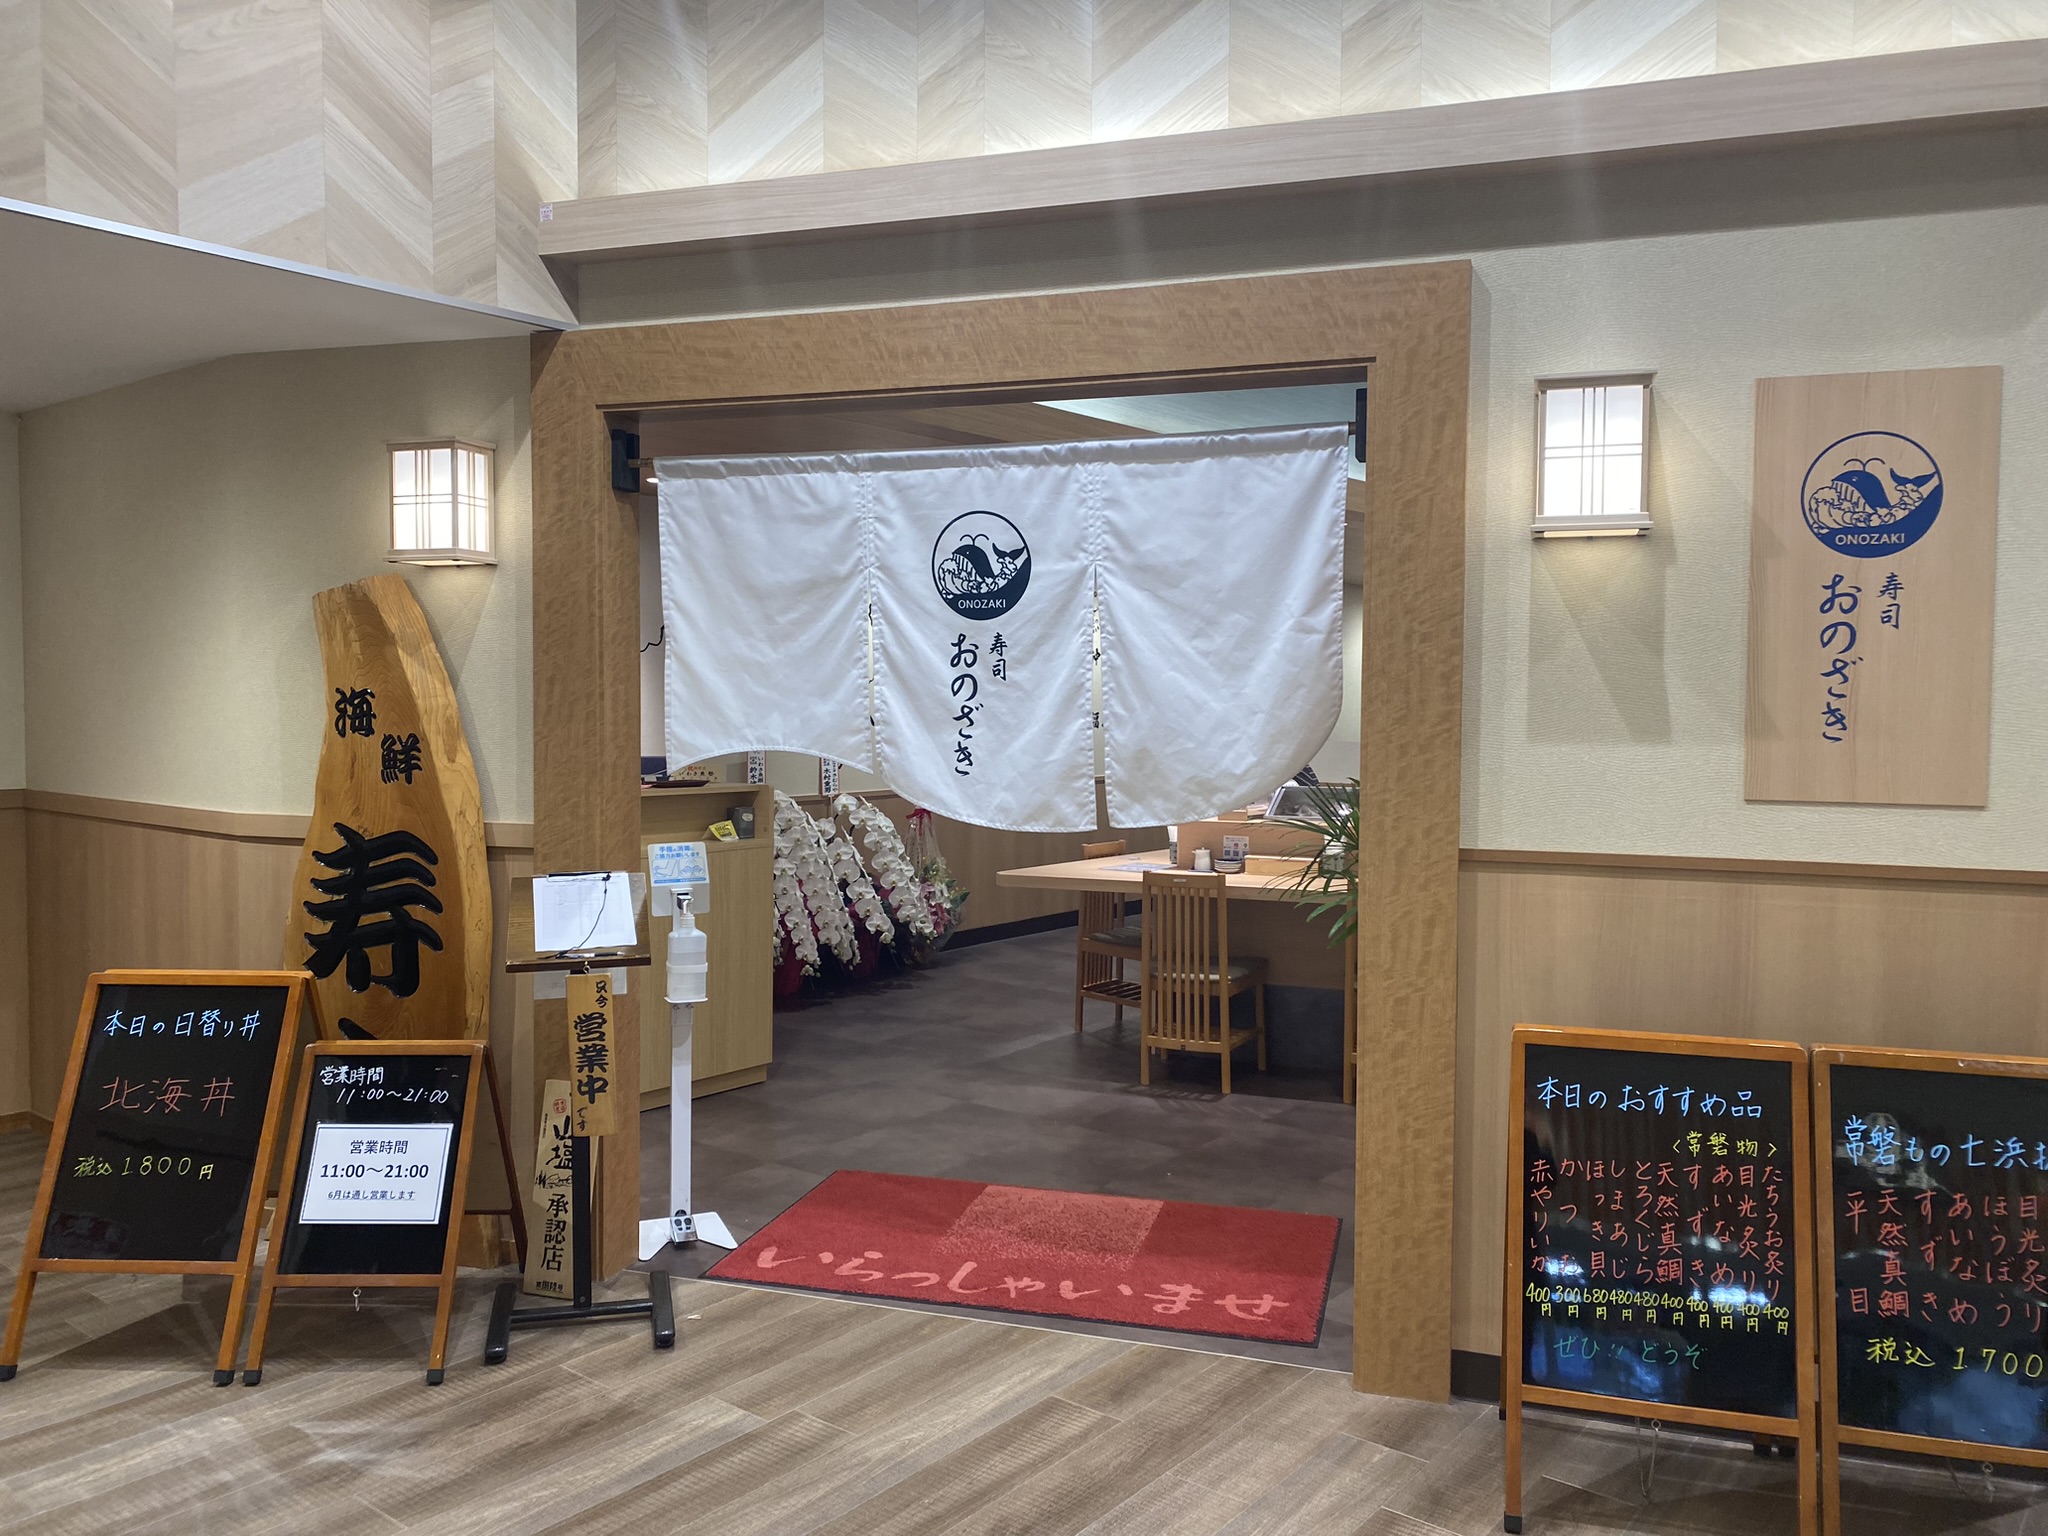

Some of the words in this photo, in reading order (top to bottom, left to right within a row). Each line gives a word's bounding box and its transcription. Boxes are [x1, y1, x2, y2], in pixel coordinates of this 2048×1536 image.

[1834, 532, 1905, 546] ONOZAKI
[958, 598, 1007, 610] ONOZAKI
[1876, 571, 1905, 630] 寿司
[988, 631, 1008, 682] 寿司
[1819, 573, 1864, 744] おのざき
[335, 686, 424, 785] 海鮮
[949, 633, 984, 777] おのざき
[303, 822, 444, 1040] 寿
[103, 1009, 261, 1041] 本日の日替り丼
[595, 980, 609, 1008] 只今
[319, 1065, 384, 1086] 営業時間
[573, 1012, 609, 1105] 営業中
[100, 1076, 236, 1118] 北海丼
[576, 1106, 588, 1132] です
[349, 1140, 408, 1155] 営業時間
[327, 1190, 416, 1201] 6月は通し営業します
[1530, 1159, 1554, 1272] 赤やりいか
[1655, 1161, 1684, 1285] 天然真鯛
[1683, 1164, 1709, 1288] すずき
[1710, 1164, 1735, 1289] あいなめ
[541, 1193, 570, 1272] 承認店
[756, 1247, 1290, 1322] いらっしゃいませ
